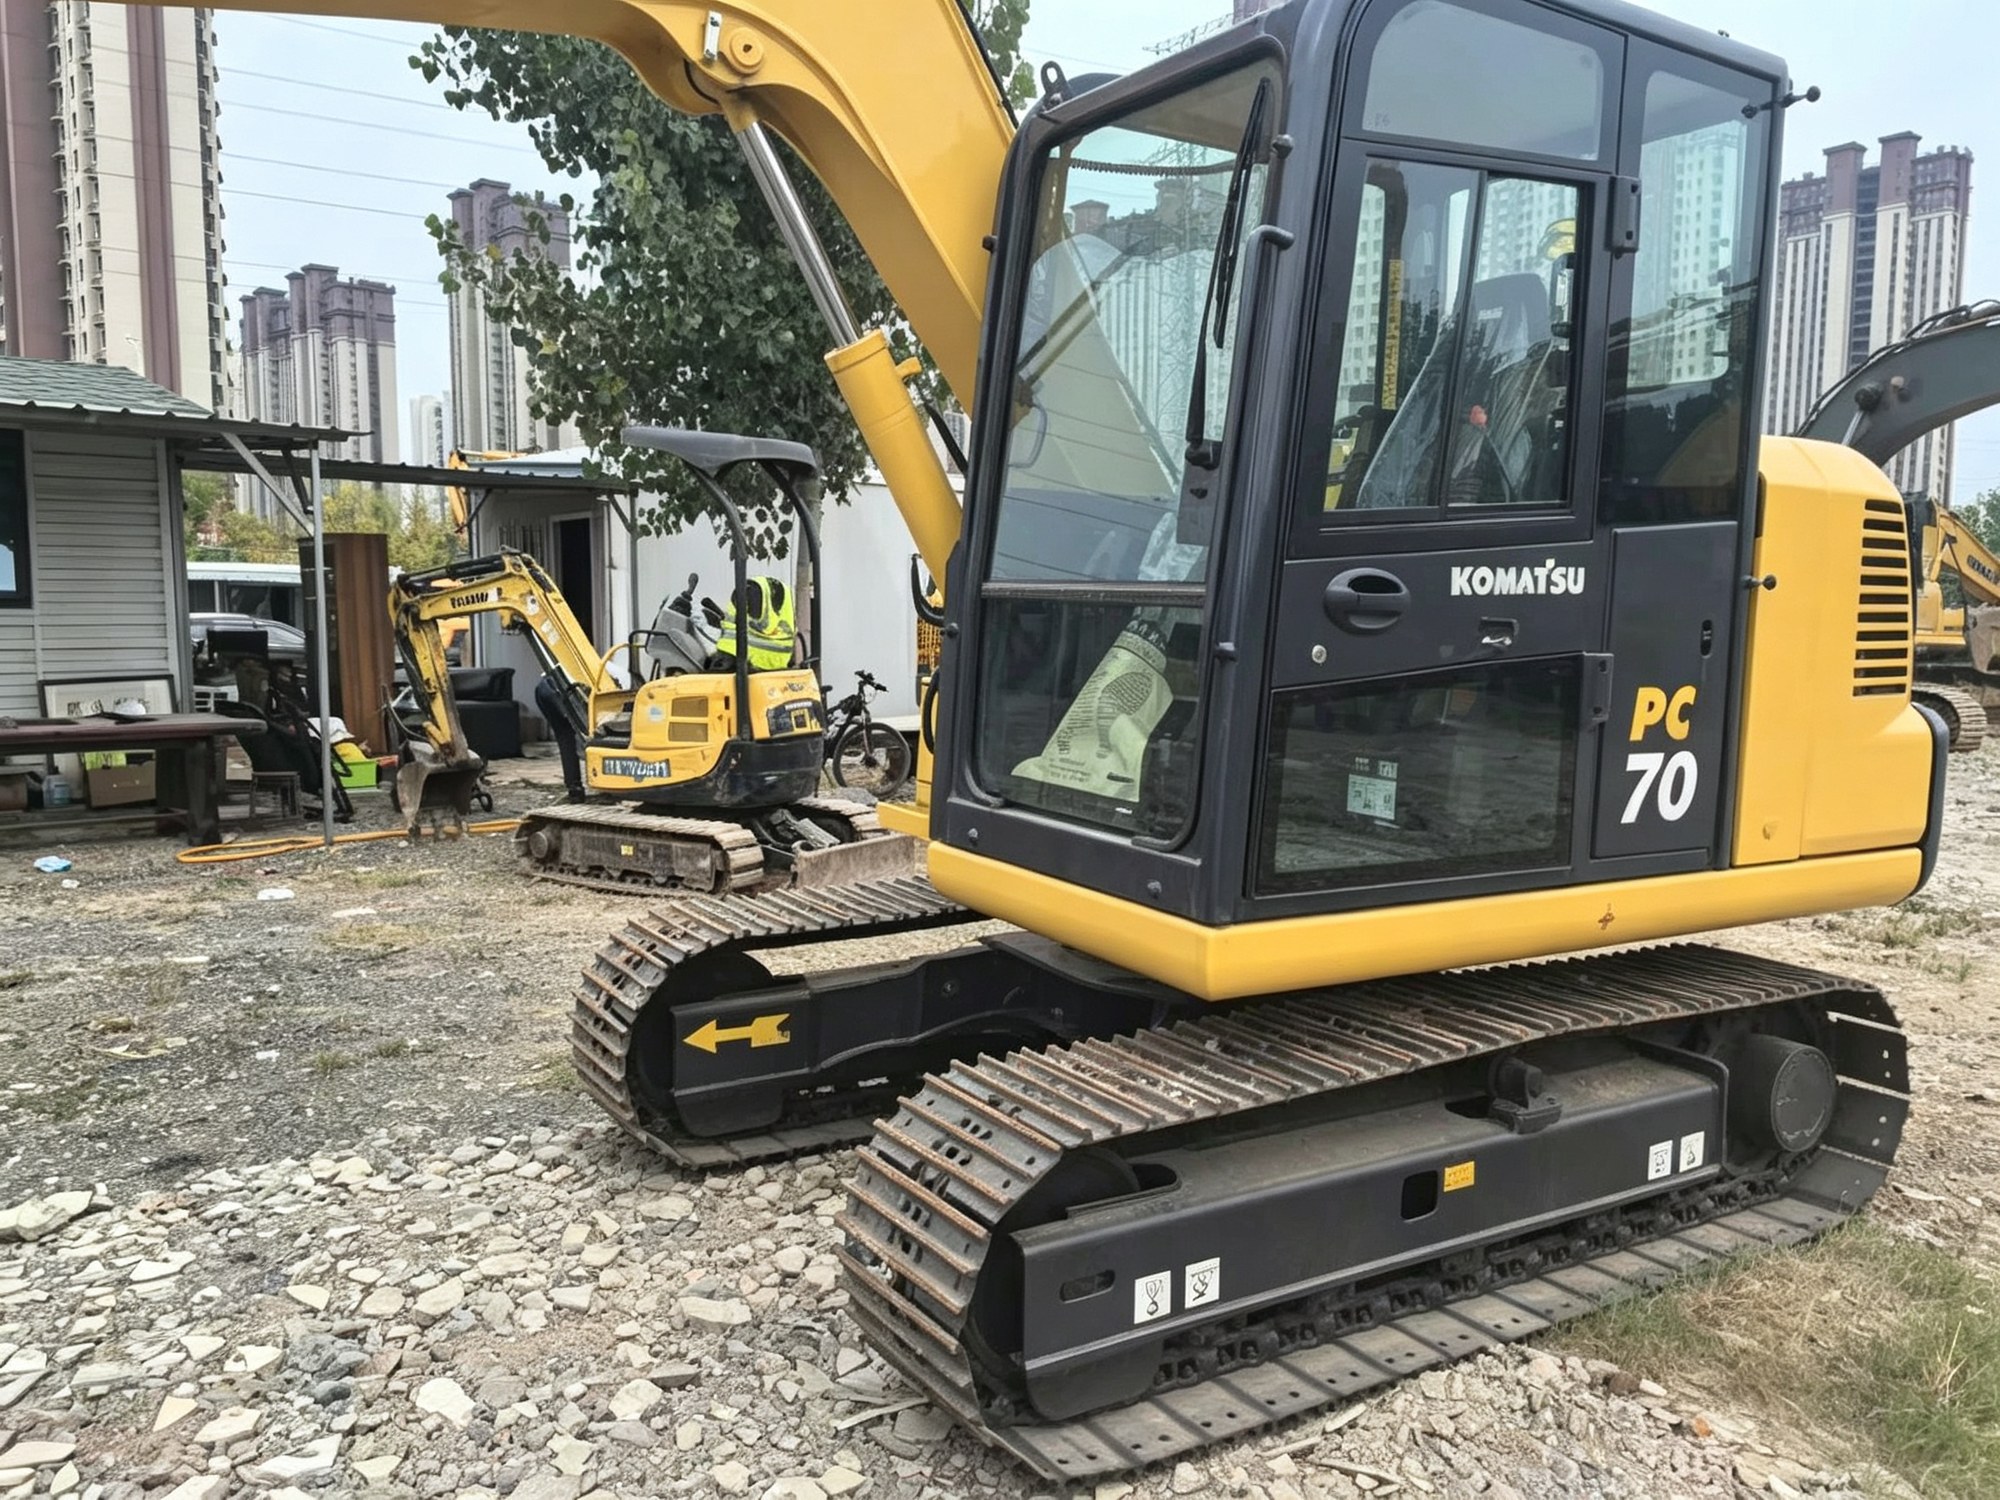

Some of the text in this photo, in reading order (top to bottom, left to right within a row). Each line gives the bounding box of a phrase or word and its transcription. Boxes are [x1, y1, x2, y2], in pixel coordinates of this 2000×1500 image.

[1450, 558, 1585, 596] KOMATSU
[1629, 685, 1697, 741] PC
[1620, 750, 1698, 824] 70
